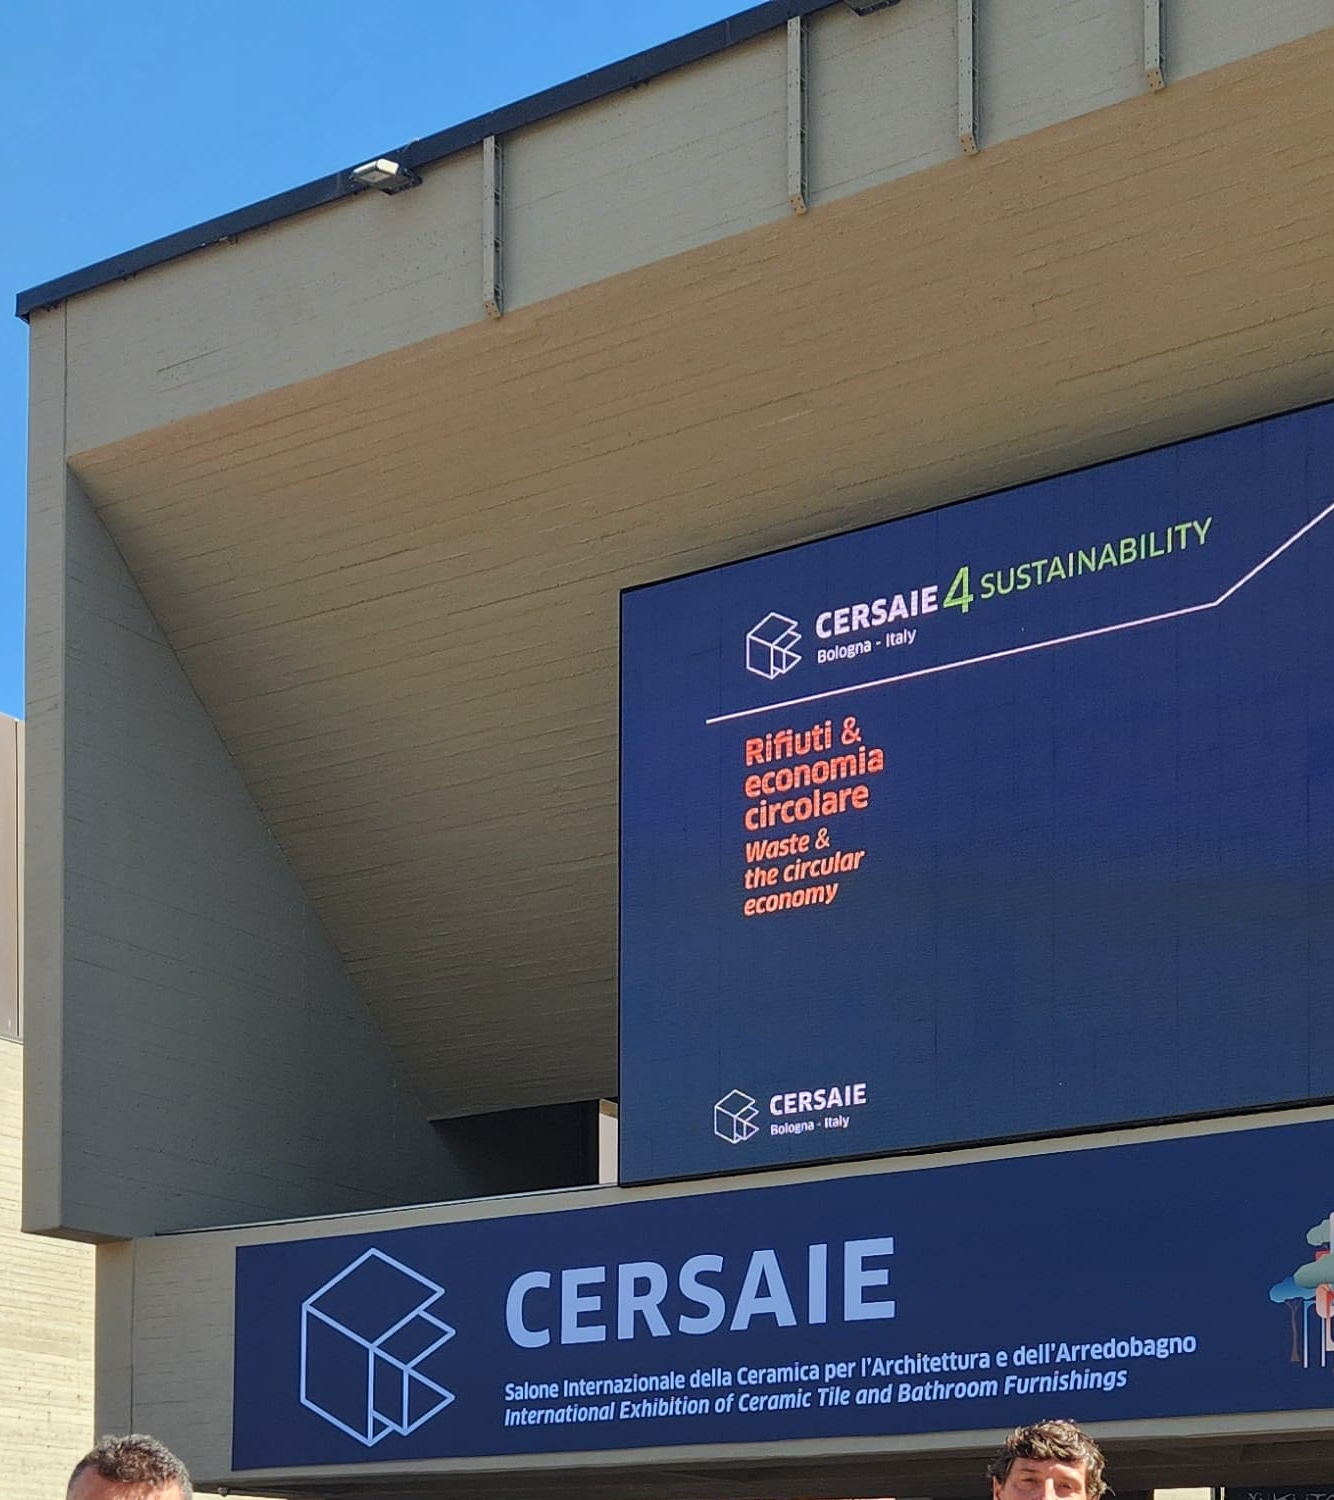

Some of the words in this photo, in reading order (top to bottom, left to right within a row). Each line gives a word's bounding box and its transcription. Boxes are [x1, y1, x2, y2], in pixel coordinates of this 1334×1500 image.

[815, 584, 939, 640] CERSAIE
[942, 565, 974, 614] 4
[979, 516, 1213, 600] SUSTAINABILITY
[816, 639, 872, 664] Bologna
[885, 628, 917, 649] Italy
[745, 719, 832, 767] Rifiuti
[840, 716, 862, 745] &
[744, 745, 884, 798] economia
[744, 784, 869, 831] circolare
[745, 832, 810, 864] Waste
[814, 826, 831, 850] &
[744, 866, 779, 890] the
[783, 850, 866, 883] circular
[743, 882, 839, 916] economy
[769, 1082, 867, 1116] CERSAIE
[770, 1120, 815, 1136] Bologna
[824, 1115, 850, 1130] Italy
[504, 1236, 896, 1348] CERSAIE
[504, 1381, 559, 1401] Salone
[564, 1371, 685, 1397] Internazionale
[689, 1367, 732, 1389] della
[737, 1361, 819, 1386] Ceramica
[824, 1361, 856, 1383] per
[996, 1351, 1008, 1368] e
[504, 1401, 616, 1427] International
[619, 1395, 709, 1420] Exhibition
[714, 1393, 735, 1414] of
[738, 1388, 812, 1412] Ceramic
[817, 1386, 850, 1407] Tile
[855, 1384, 893, 1405] and
[898, 1379, 998, 1403] Bathroom
[1004, 1368, 1128, 1396] Furnishings
